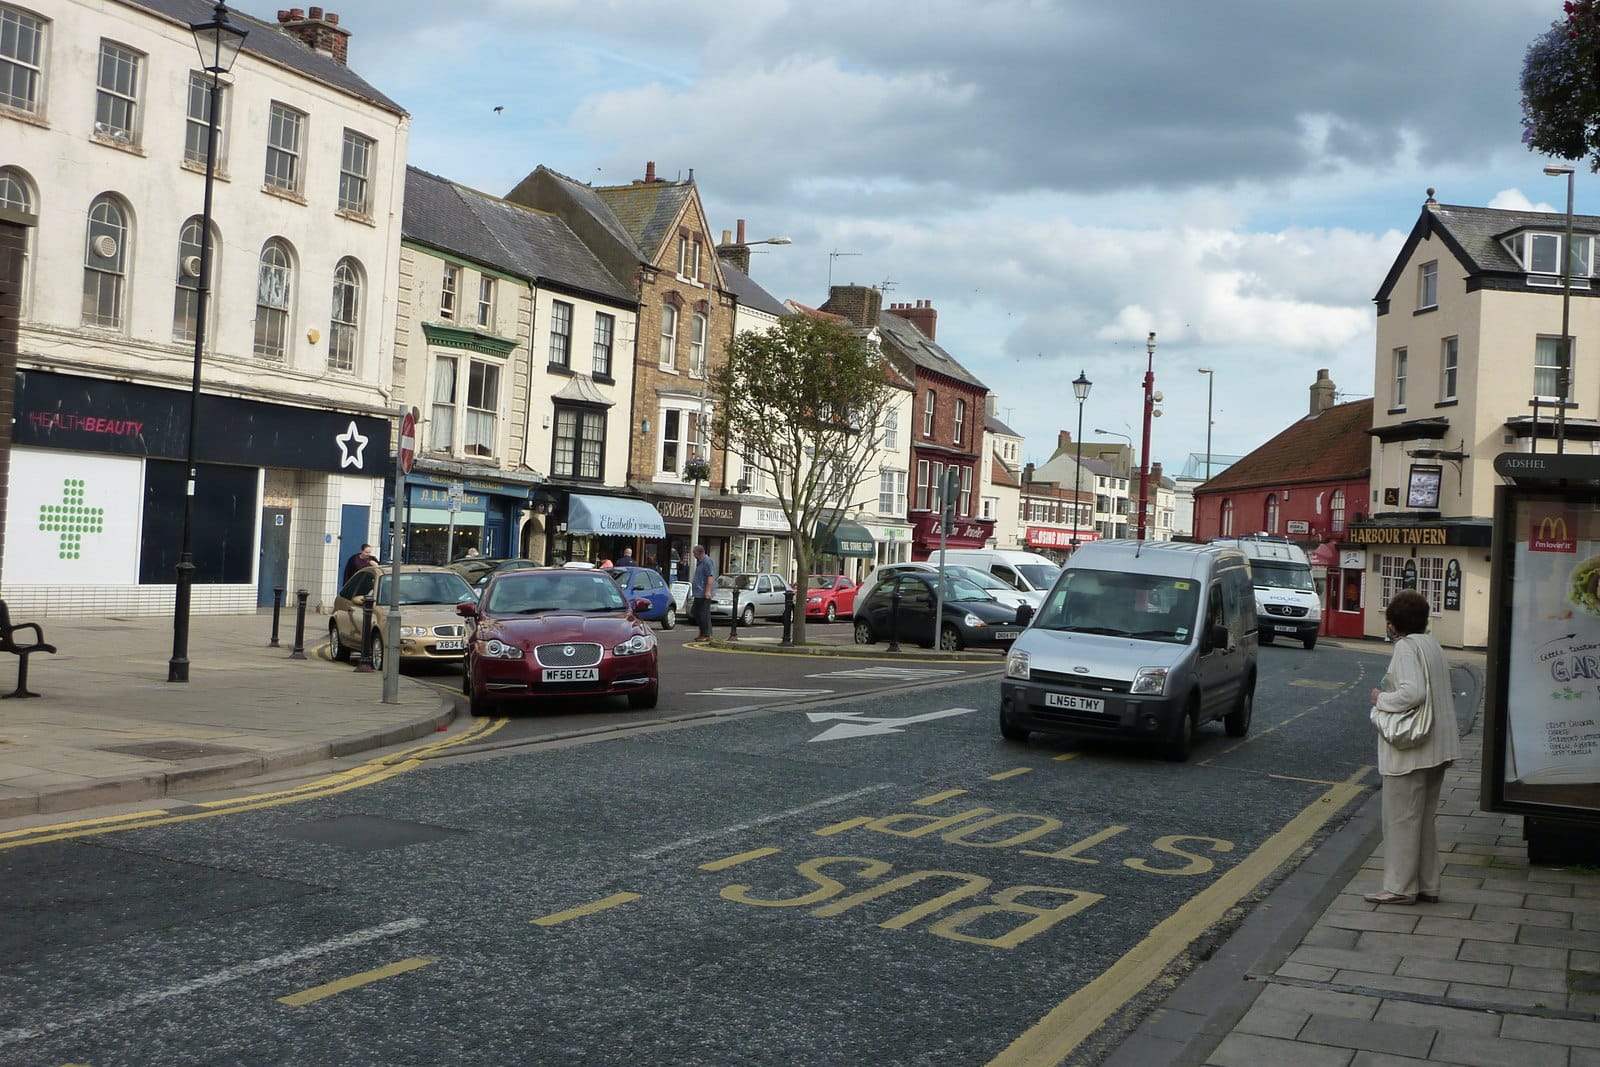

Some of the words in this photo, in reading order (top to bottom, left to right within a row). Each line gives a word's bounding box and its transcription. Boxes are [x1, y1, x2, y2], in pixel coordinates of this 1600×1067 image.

[1505, 459, 1546, 469] ADSHEL
[656, 501, 695, 519] GEORGE
[1350, 528, 1400, 544] HARBOUR
[1402, 529, 1447, 545] TAVERN
[1269, 595, 1301, 603] POLICE
[546, 671, 573, 680] WF58
[575, 670, 594, 680] EZA
[1049, 696, 1077, 706] LN56
[1079, 699, 1100, 710] TMY
[865, 807, 1235, 876] STOP
[719, 857, 1107, 950] BUS
